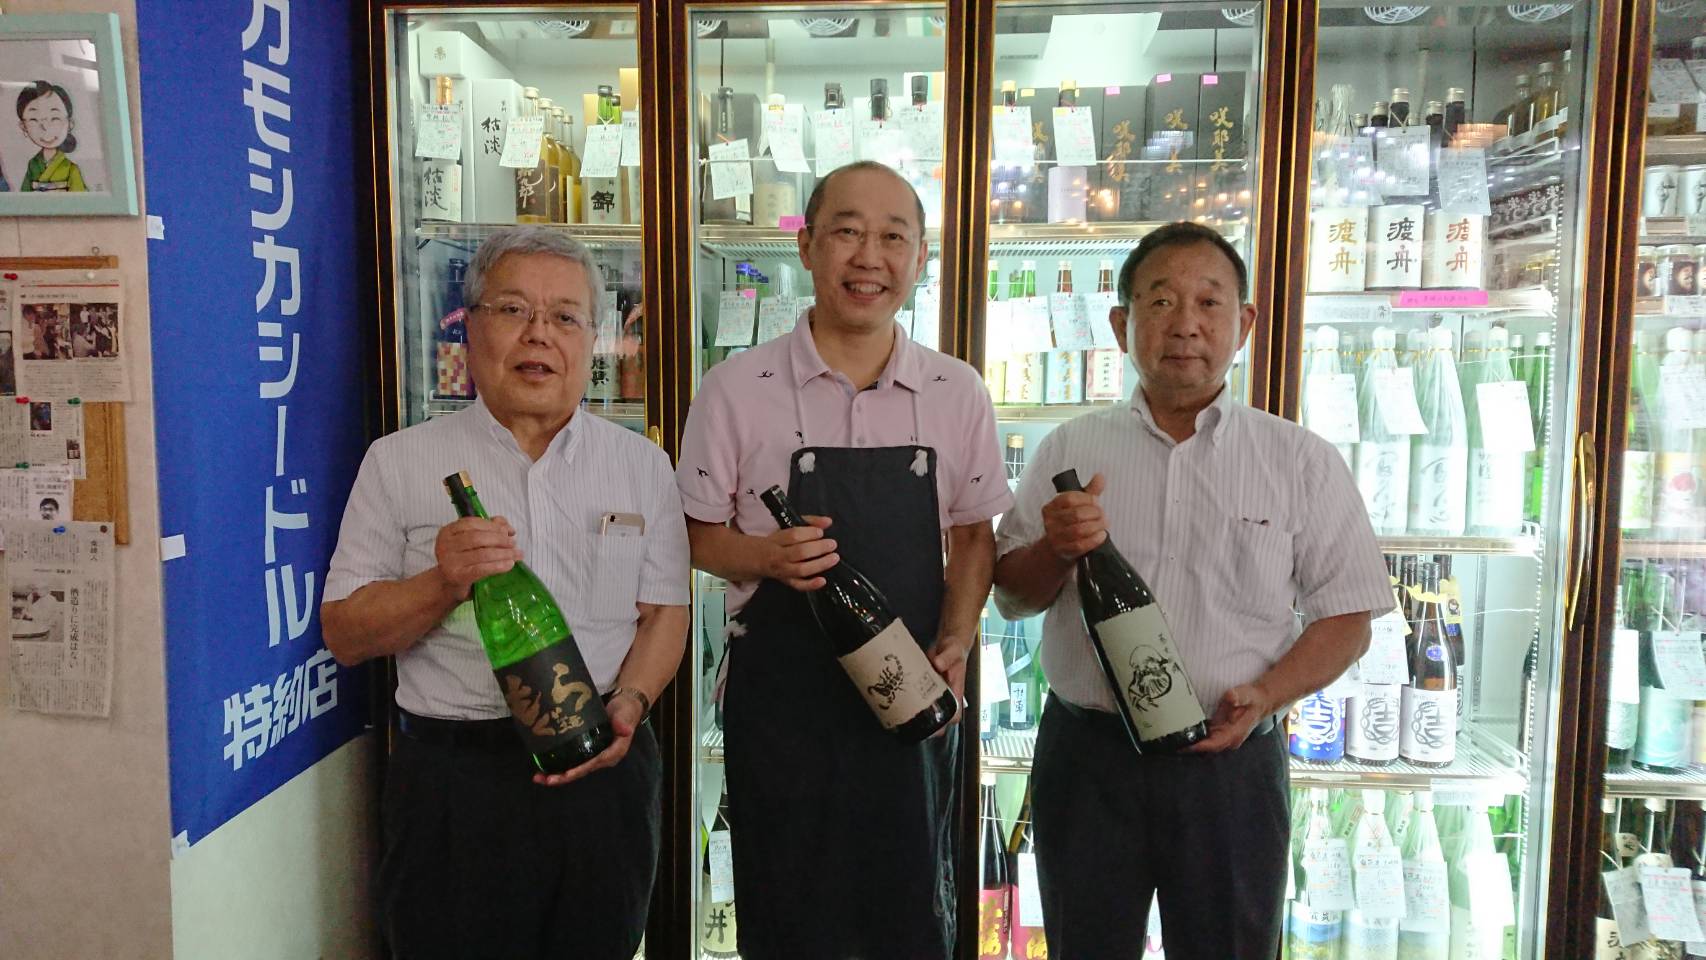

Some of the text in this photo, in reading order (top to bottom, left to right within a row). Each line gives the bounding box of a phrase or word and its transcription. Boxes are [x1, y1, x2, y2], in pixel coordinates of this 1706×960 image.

[1329, 218, 1357, 275] 渡舟
[1387, 217, 1416, 273] 渡舟
[1446, 218, 1470, 274] 渡舟
[223, 649, 339, 771] 特約店
